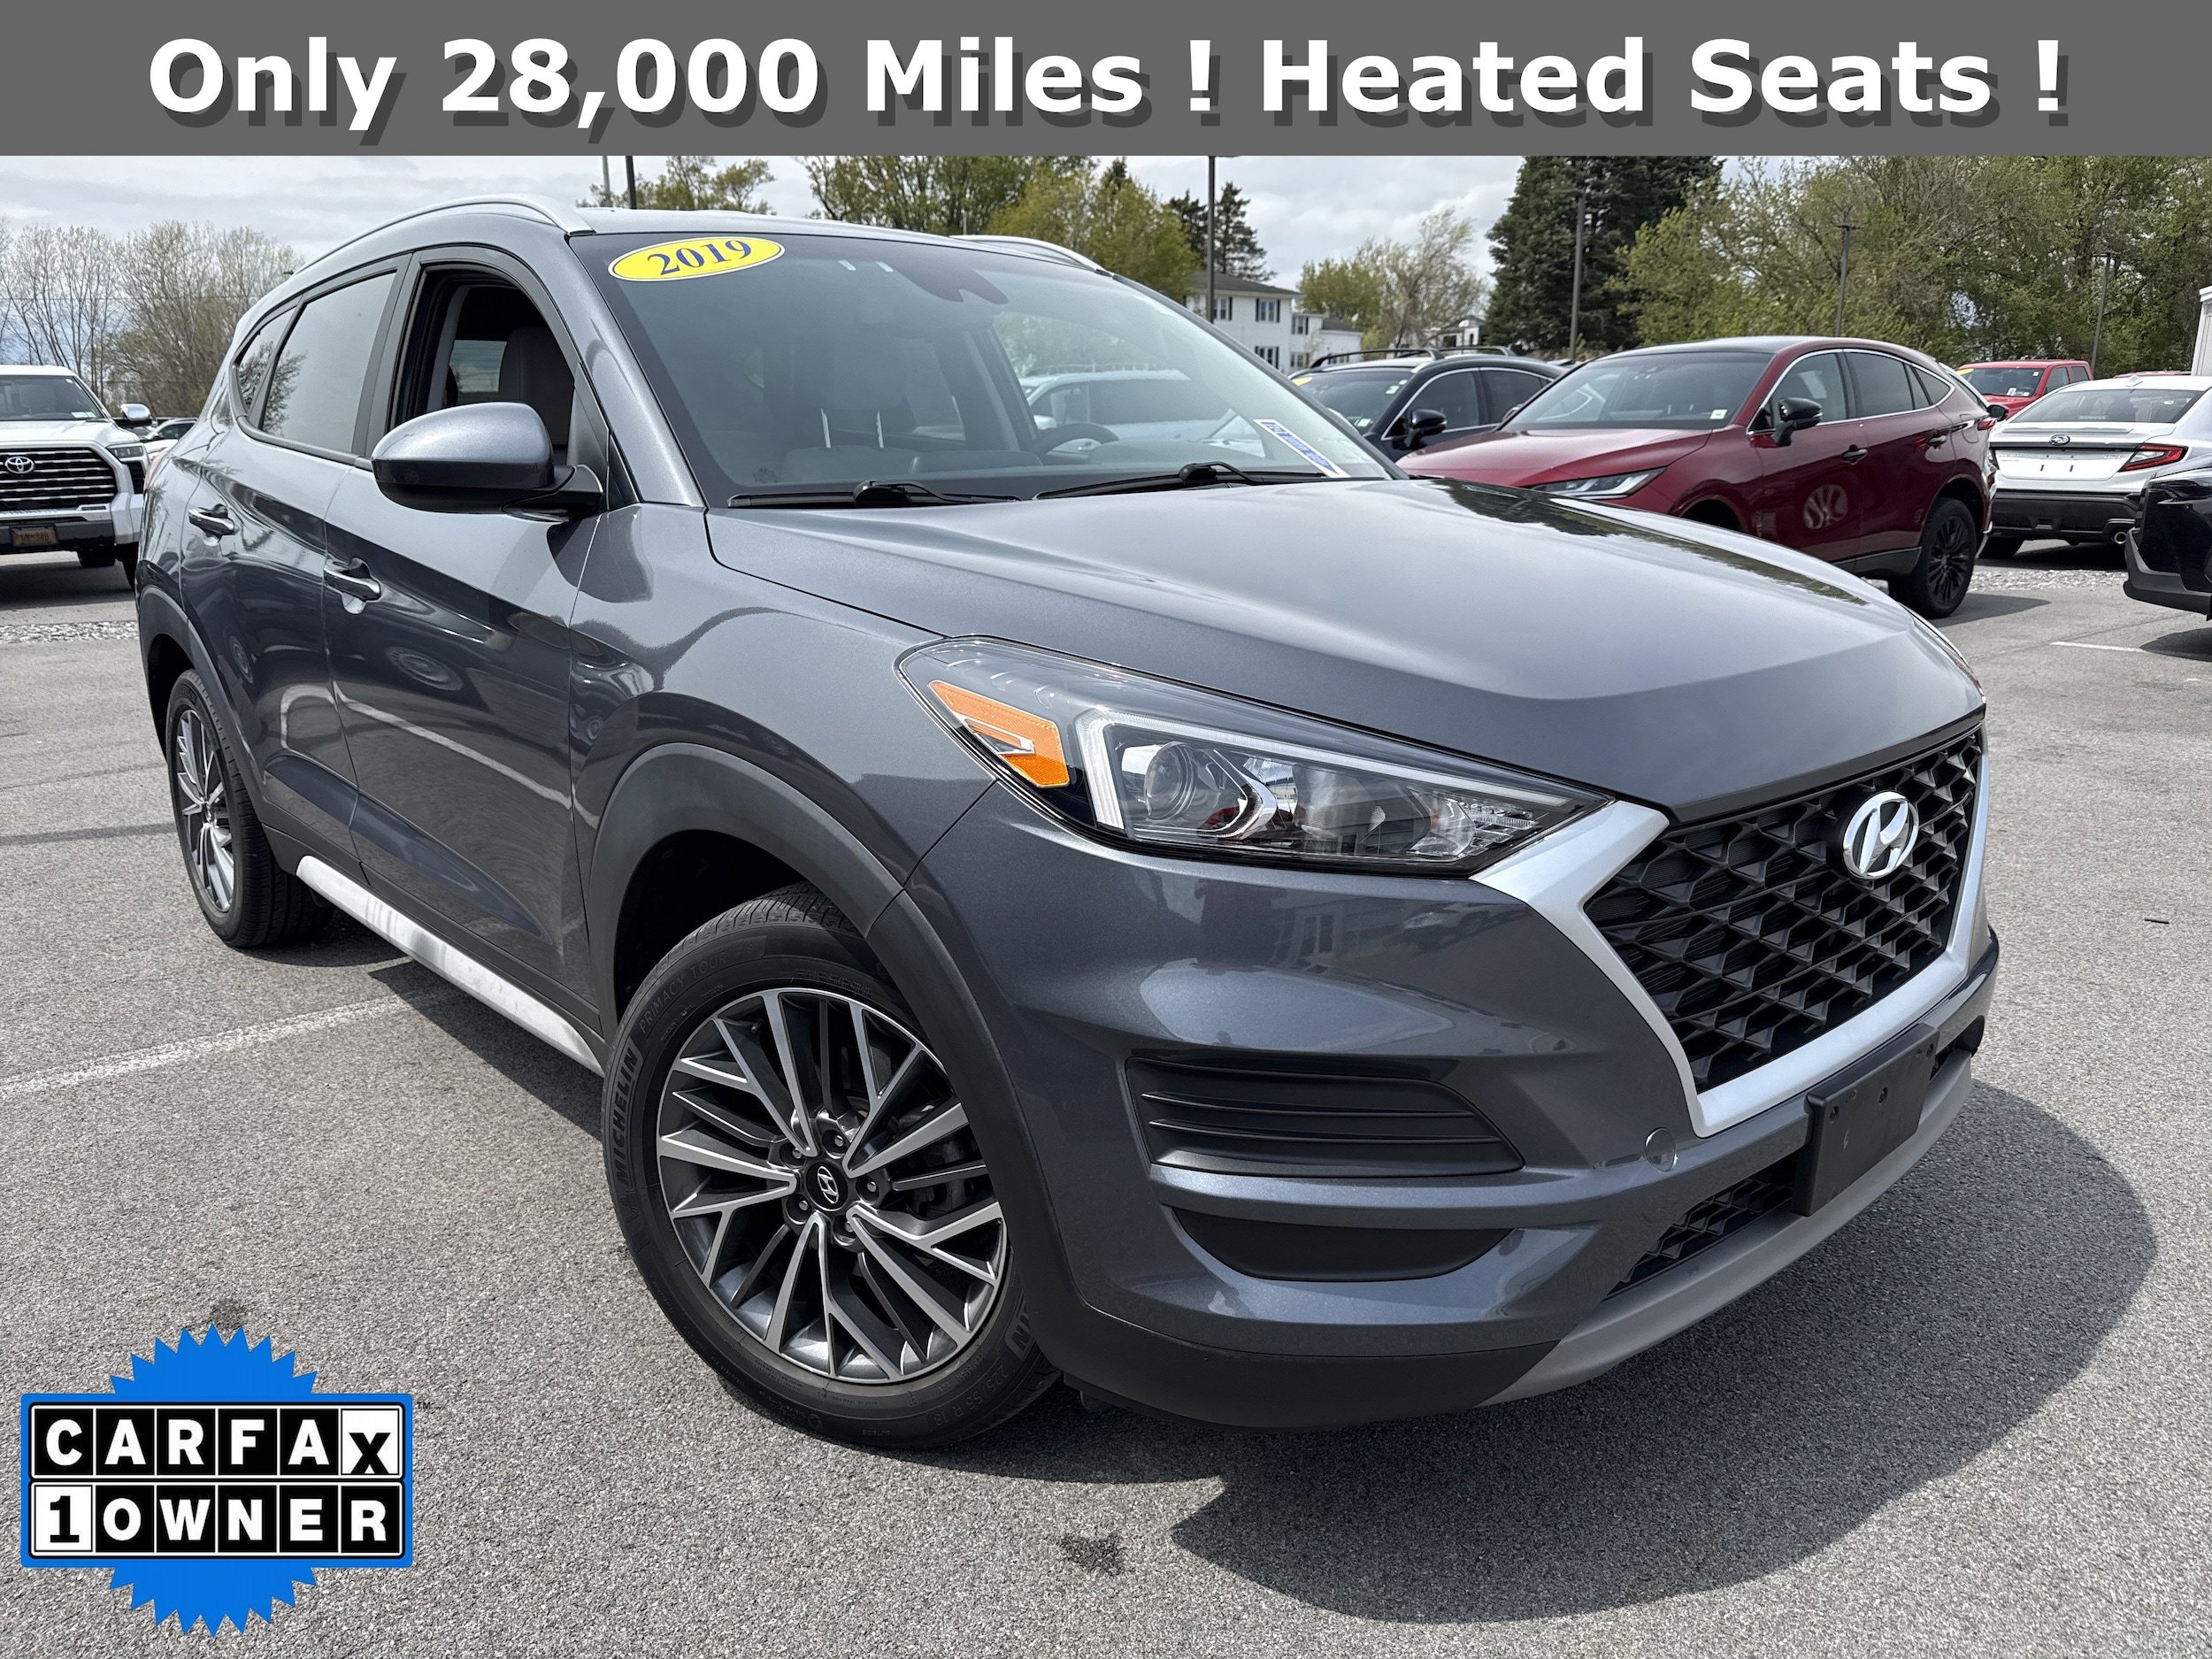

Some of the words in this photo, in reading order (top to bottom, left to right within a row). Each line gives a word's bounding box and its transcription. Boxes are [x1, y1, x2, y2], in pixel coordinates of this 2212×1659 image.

[647, 239, 753, 276] 2019
[638, 973, 686, 1034] PRIMACY
[691, 950, 729, 978] TOUR
[611, 1046, 639, 1187] MICHELIN
